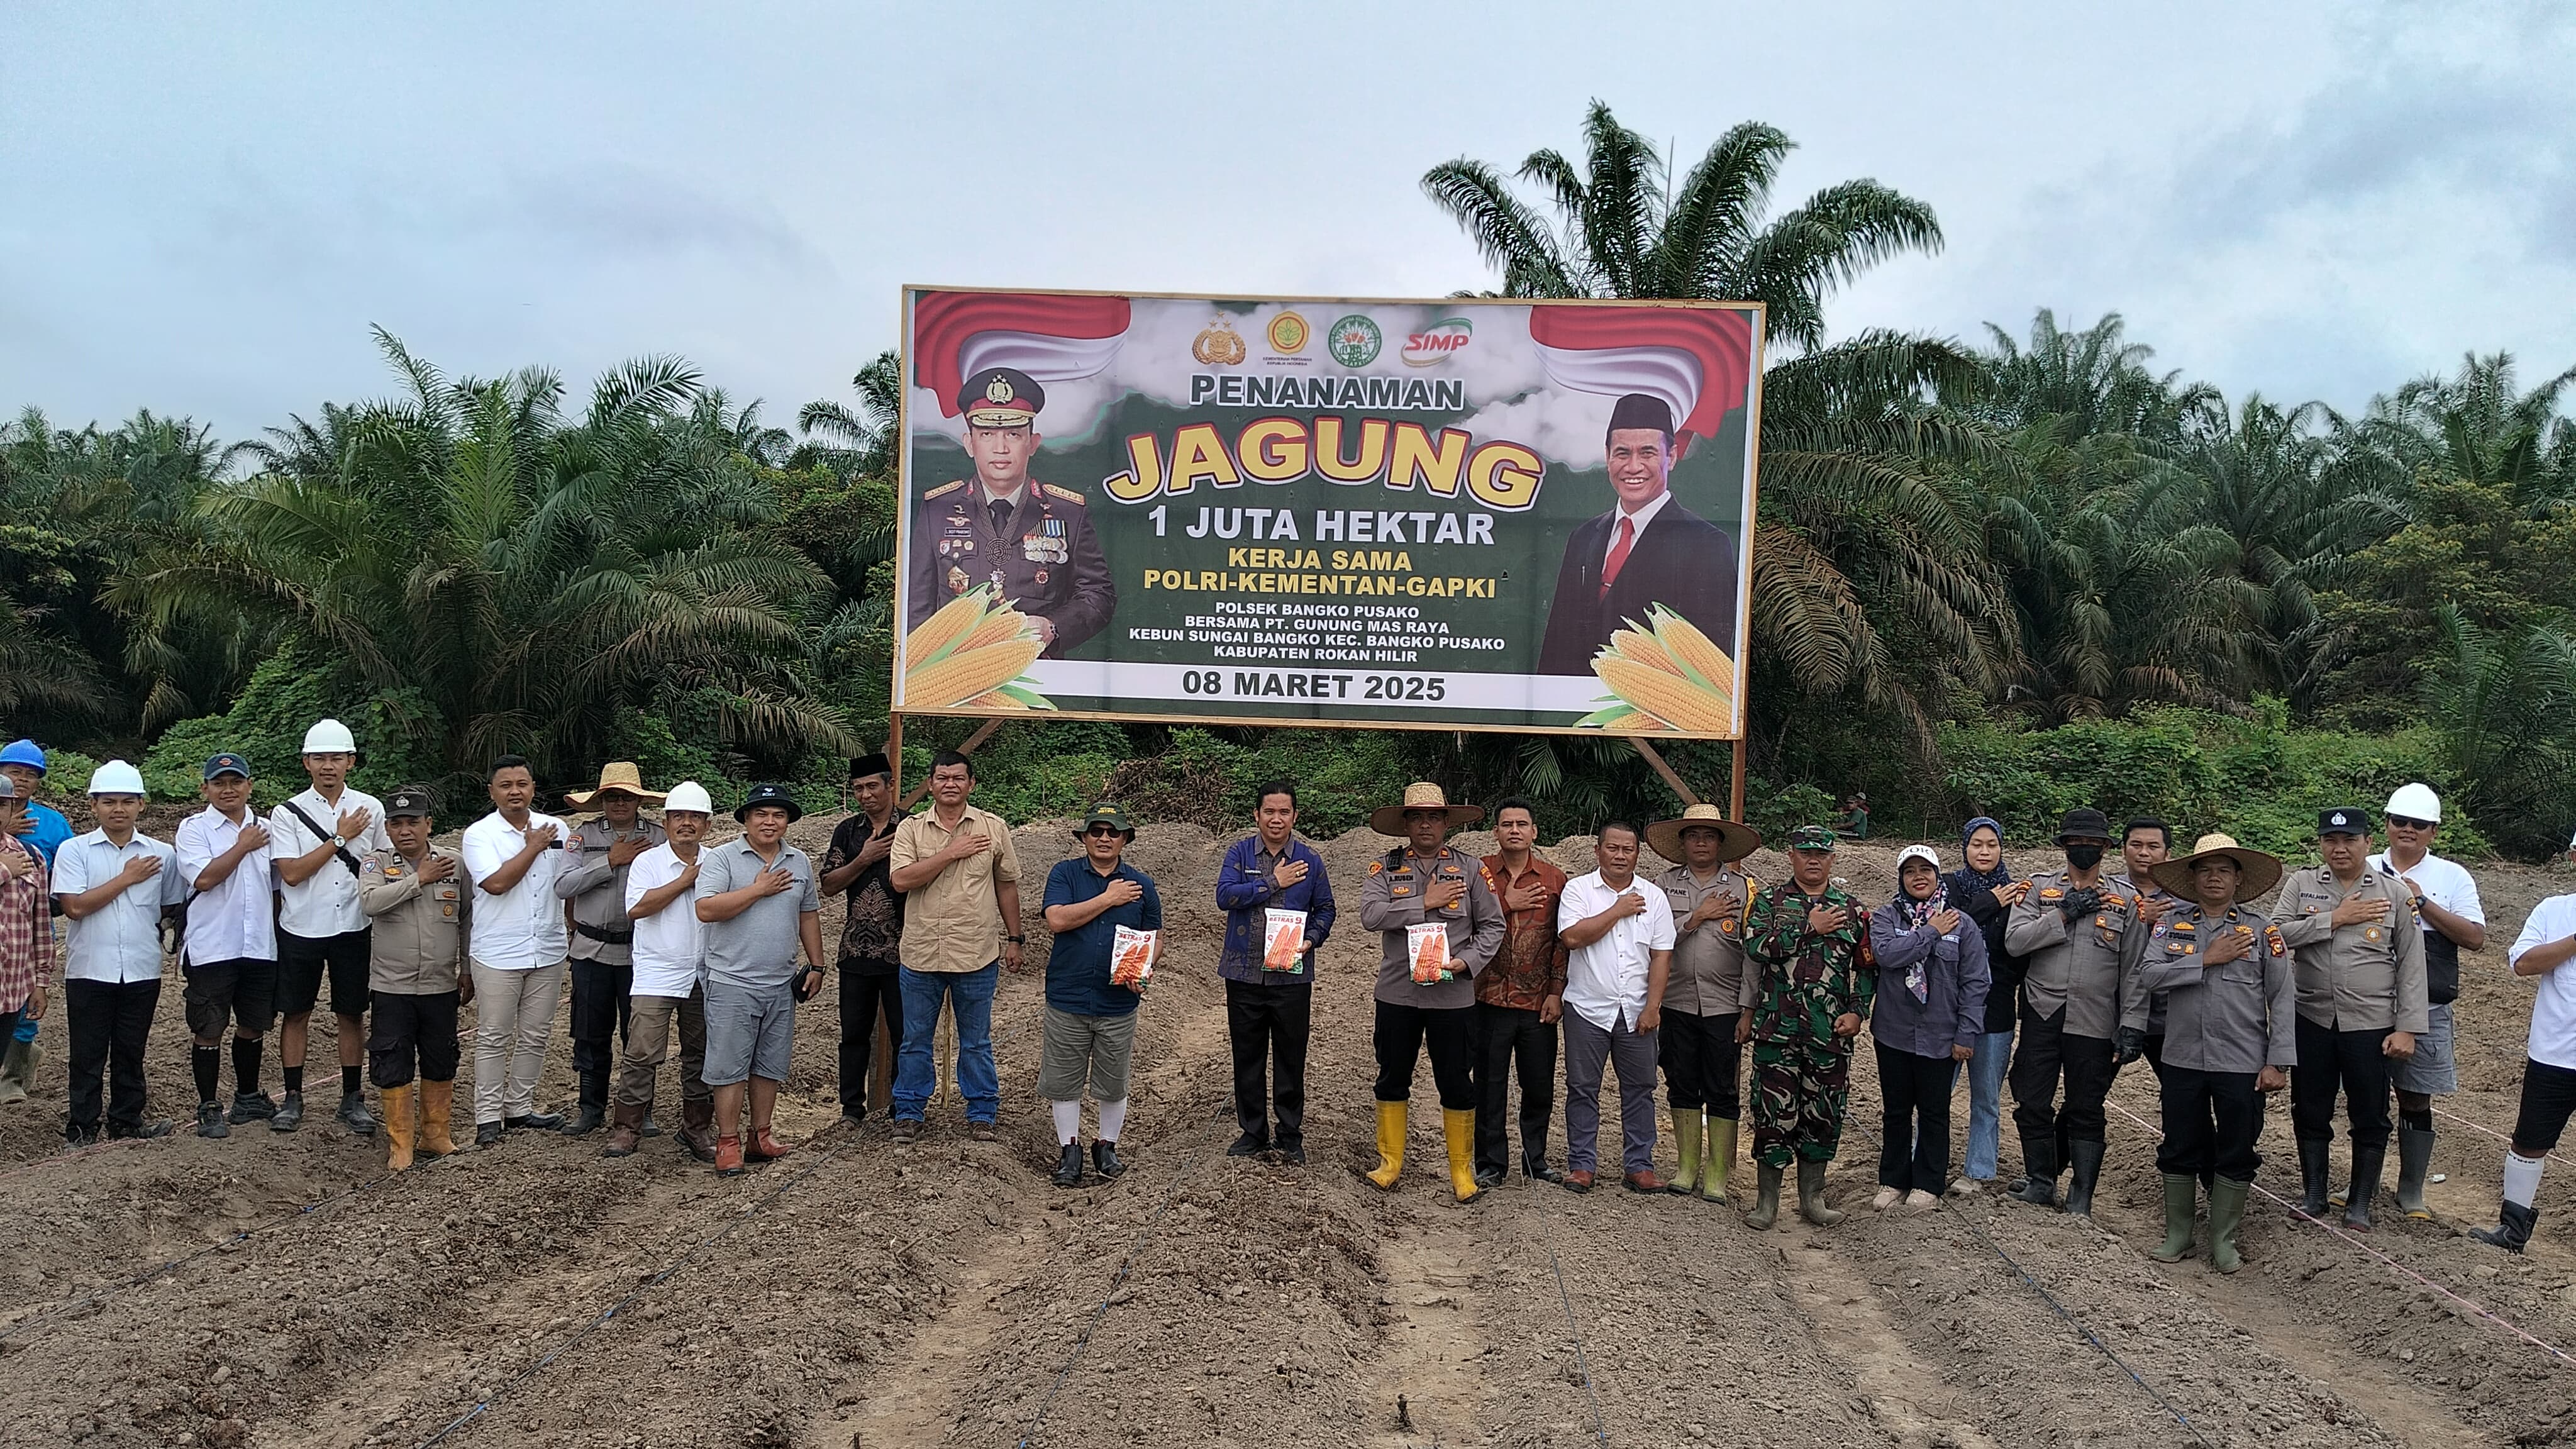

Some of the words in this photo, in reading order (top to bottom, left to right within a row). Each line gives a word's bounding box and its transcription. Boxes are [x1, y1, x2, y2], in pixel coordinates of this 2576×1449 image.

[1404, 333, 1469, 351] SIMP
[1190, 374, 1463, 410] PENANAMAN
[1104, 417, 1545, 511] JAGUNG
[1148, 505, 1165, 536] 1
[1185, 507, 1299, 540] JUTA
[1316, 510, 1495, 545] HEKTAR
[1228, 548, 1321, 569] KERJA
[1331, 550, 1412, 571] SAMA
[1144, 570, 1496, 599] POLRI-KEMENTAN-GAPKI
[1215, 602, 1277, 615] POLSEK
[1282, 604, 1349, 616] BANGKO
[1354, 606, 1419, 618] PUSAKO
[1185, 616, 1260, 629] BERSAMA
[1265, 618, 1289, 630] PT.
[1294, 619, 1363, 631] GUNUNG
[1367, 621, 1402, 633] MAS
[1406, 622, 1450, 634] RAYA
[1130, 628, 1184, 641] KEBUN
[1189, 630, 1248, 643] SUNGAI
[1253, 632, 1320, 645] BANGKO
[1325, 634, 1362, 647] KEC.
[1367, 635, 1434, 648] BANGKO
[1439, 638, 1505, 650] PUSAKO
[1214, 646, 1309, 660] KABUPATEN
[1314, 648, 1370, 661] ROKAN
[1375, 650, 1418, 662] HILIR
[1182, 670, 1222, 695] 08
[1234, 672, 1353, 698] MARET
[1363, 675, 1445, 701] 2025
[1670, 888, 1687, 896] PANE
[1119, 933, 1143, 941] BETRAS
[1143, 934, 1151, 942] 9
